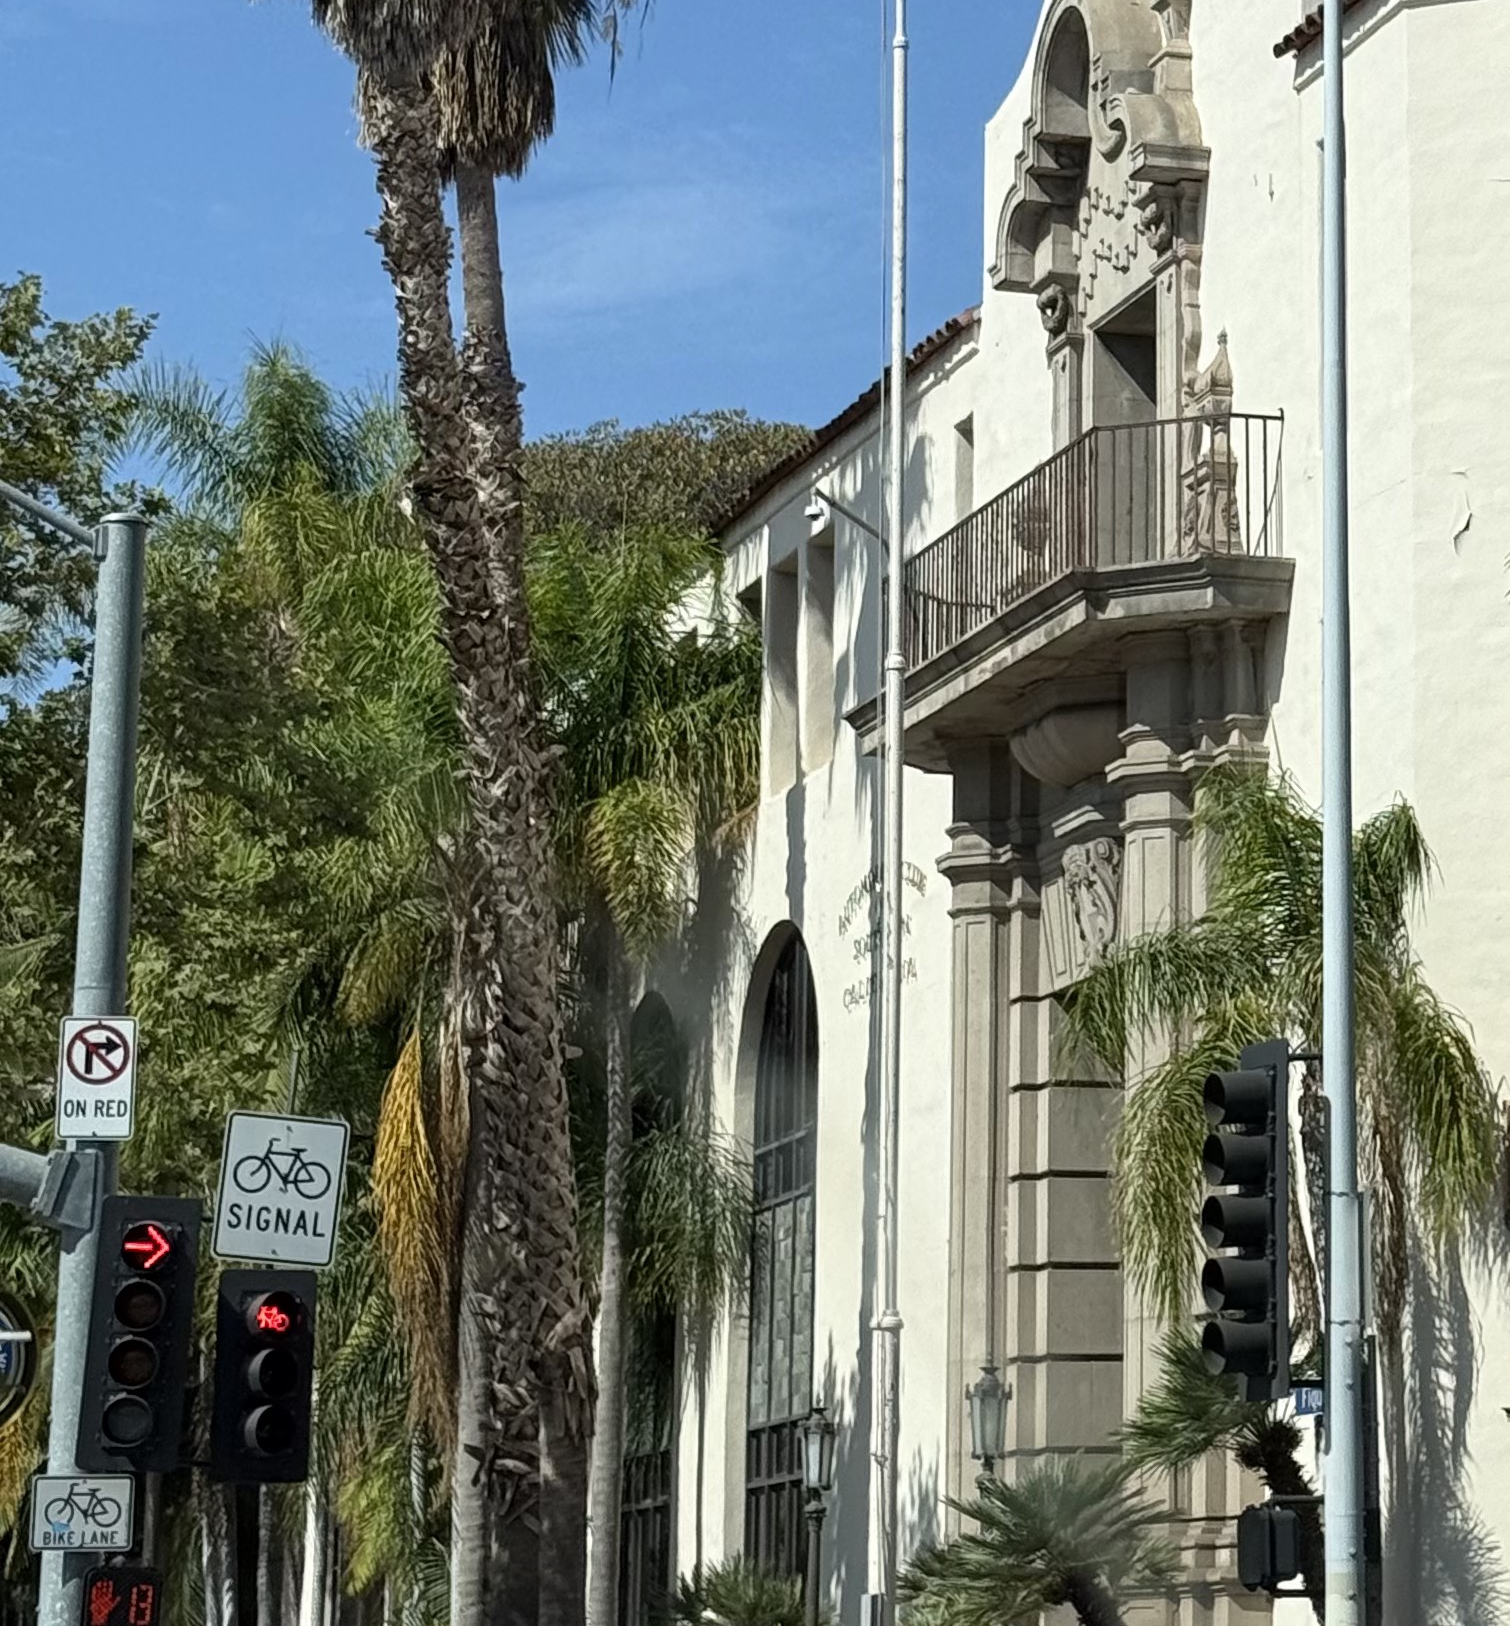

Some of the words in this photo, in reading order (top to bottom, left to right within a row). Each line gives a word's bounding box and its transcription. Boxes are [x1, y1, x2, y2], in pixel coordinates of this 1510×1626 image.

[63, 1099, 87, 1118] ON
[94, 1099, 128, 1118] RED
[227, 1203, 326, 1238] SIGNAL
[43, 1530, 75, 1546] BIKE
[82, 1530, 119, 1545] LANE
